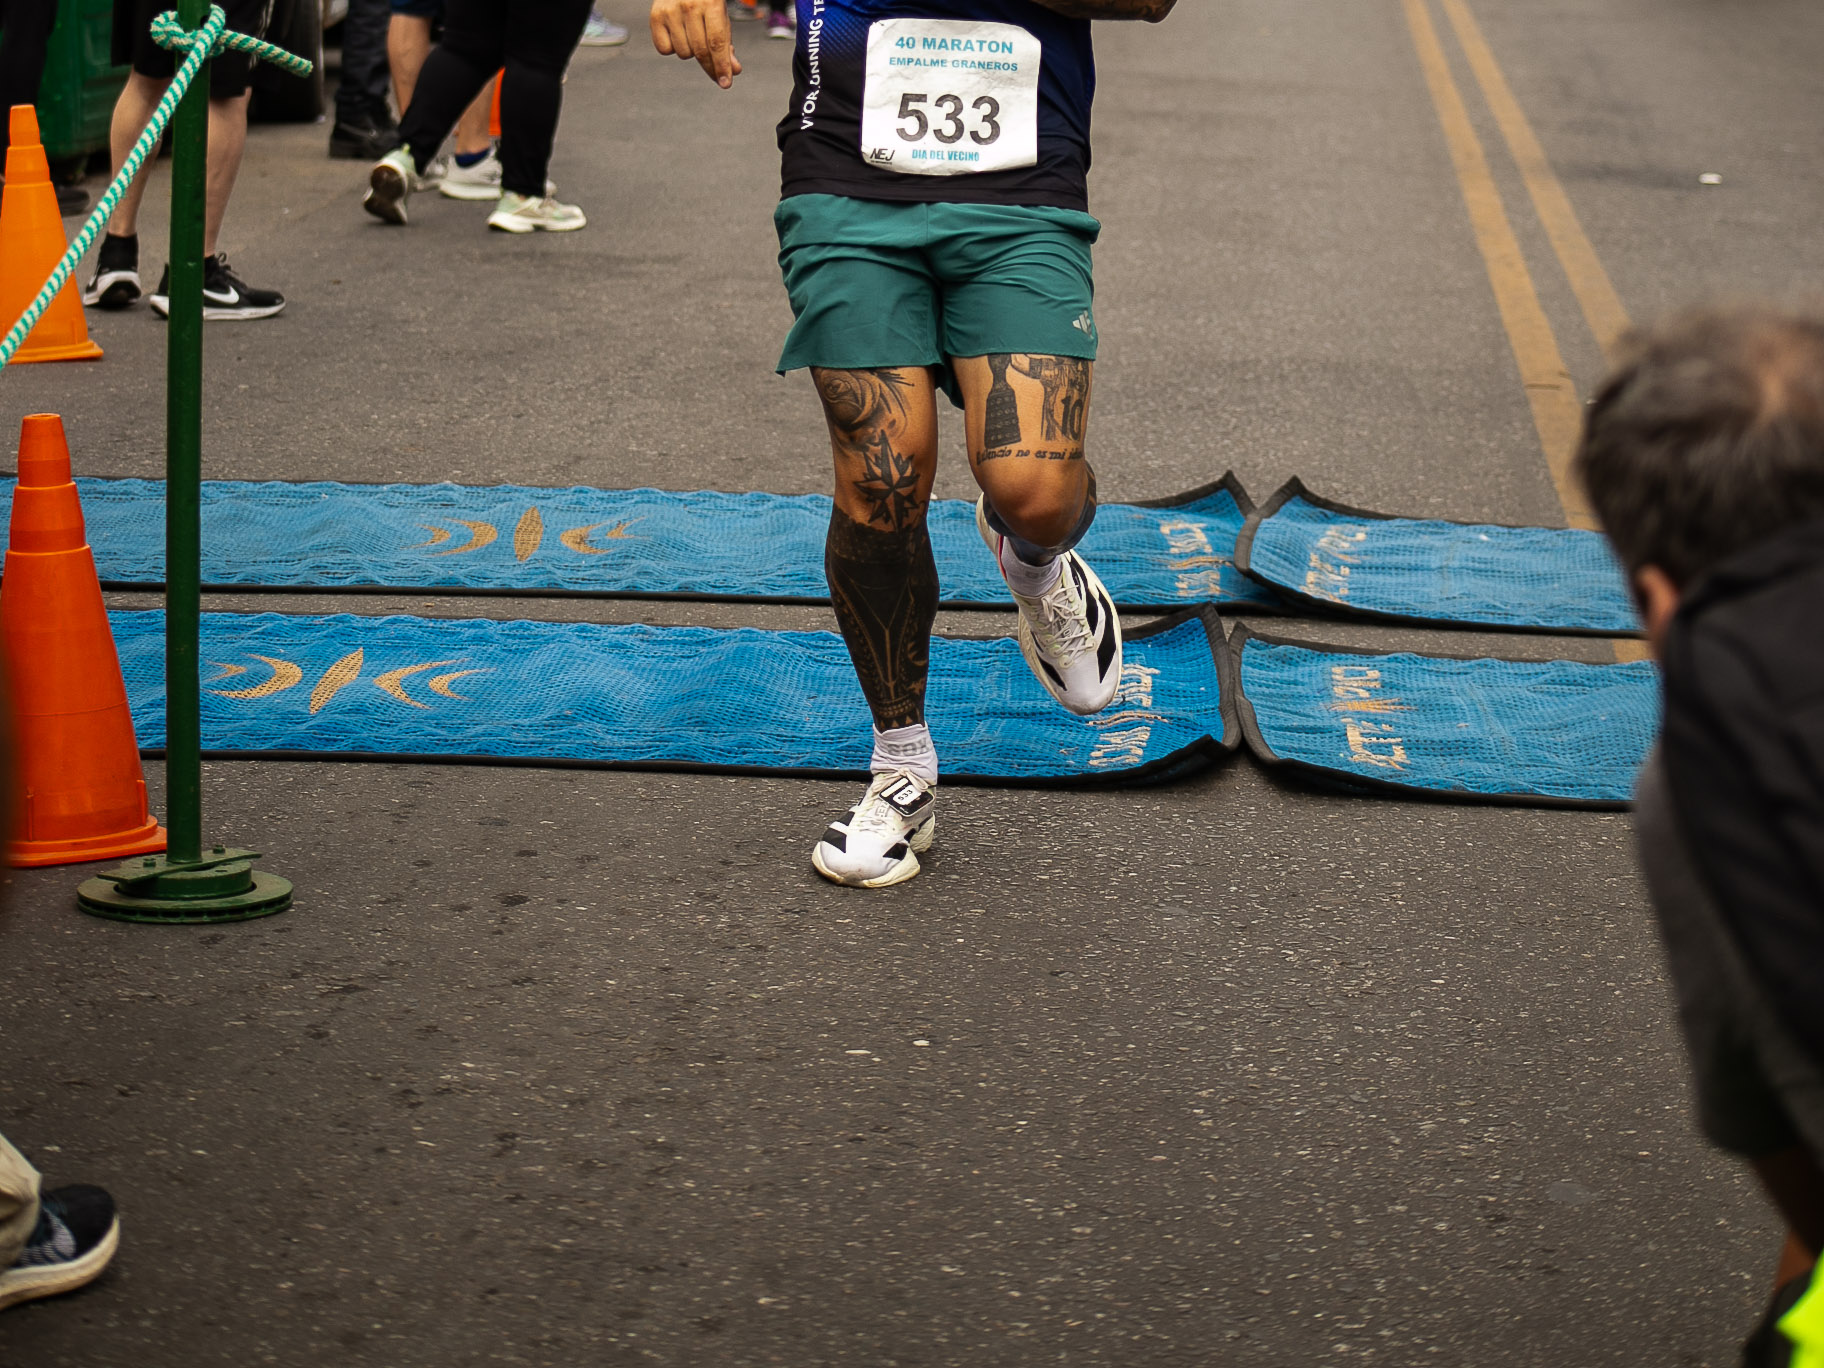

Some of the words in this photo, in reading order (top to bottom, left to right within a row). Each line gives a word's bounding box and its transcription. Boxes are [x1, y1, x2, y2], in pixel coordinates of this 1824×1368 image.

[895, 36, 916, 49] 40
[922, 37, 1014, 54] MARATON
[808, 18, 824, 88] UNNING
[889, 57, 947, 68] EMPALME
[952, 59, 1018, 72] GRANEROS
[896, 93, 1000, 145] 533
[870, 148, 895, 161] NEJ
[912, 149, 927, 160] DIA
[929, 150, 945, 160] DEL
[947, 151, 980, 161] VECINO
[897, 789, 913, 801] 533
